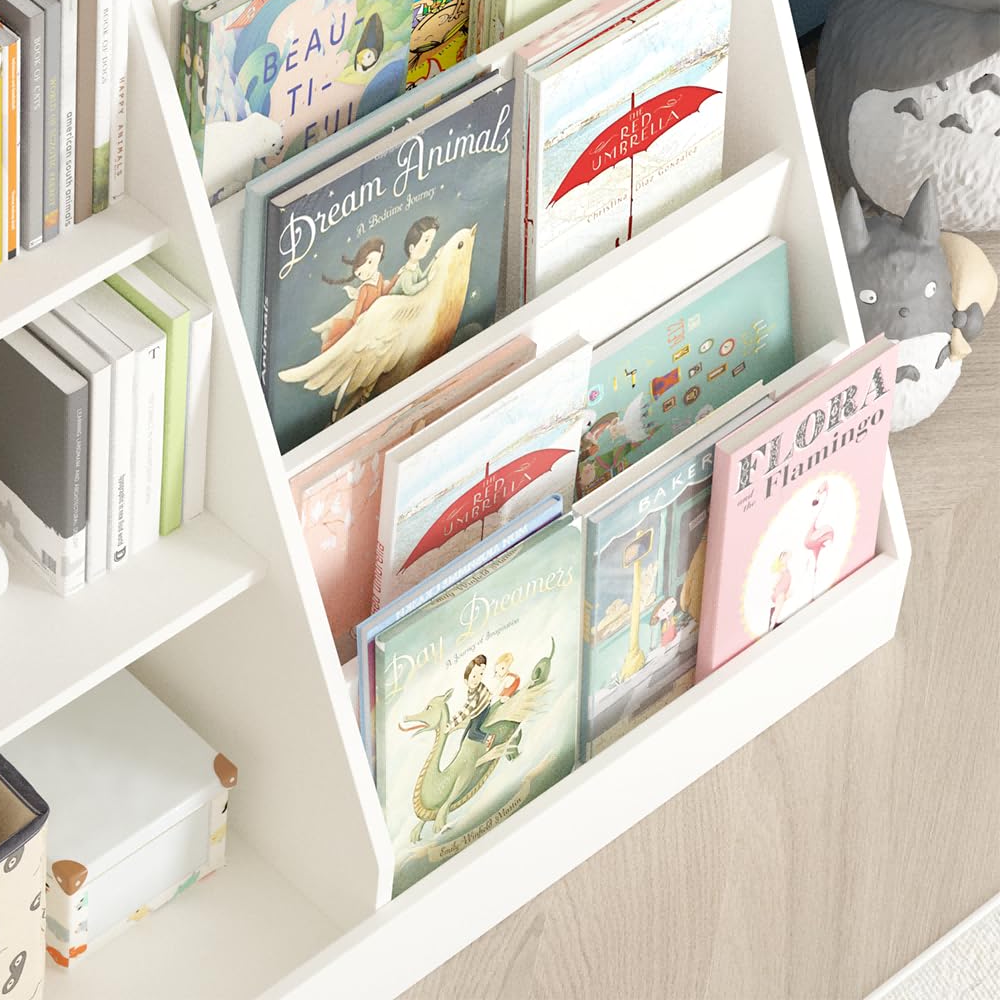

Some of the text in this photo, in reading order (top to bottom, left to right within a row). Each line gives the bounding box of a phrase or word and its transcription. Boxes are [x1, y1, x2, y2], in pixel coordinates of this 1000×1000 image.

[102, 8, 110, 36] BOOK
[263, 11, 365, 85] BEAU-
[32, 37, 41, 66] BOOK
[116, 124, 124, 178] ANIMALS
[592, 110, 680, 171] UMBRELLA
[620, 113, 653, 140] RED
[64, 112, 74, 227] american south animals
[279, 104, 511, 280] Dream Animals
[369, 204, 404, 229] Bedtime
[405, 187, 437, 212] Journey
[587, 193, 628, 223] Christina
[735, 366, 890, 495] FLORA
[765, 409, 884, 499] Flamingo
[737, 489, 754, 507] and
[743, 502, 756, 513] the
[384, 634, 445, 698] Day
[457, 565, 573, 645] Dreamers
